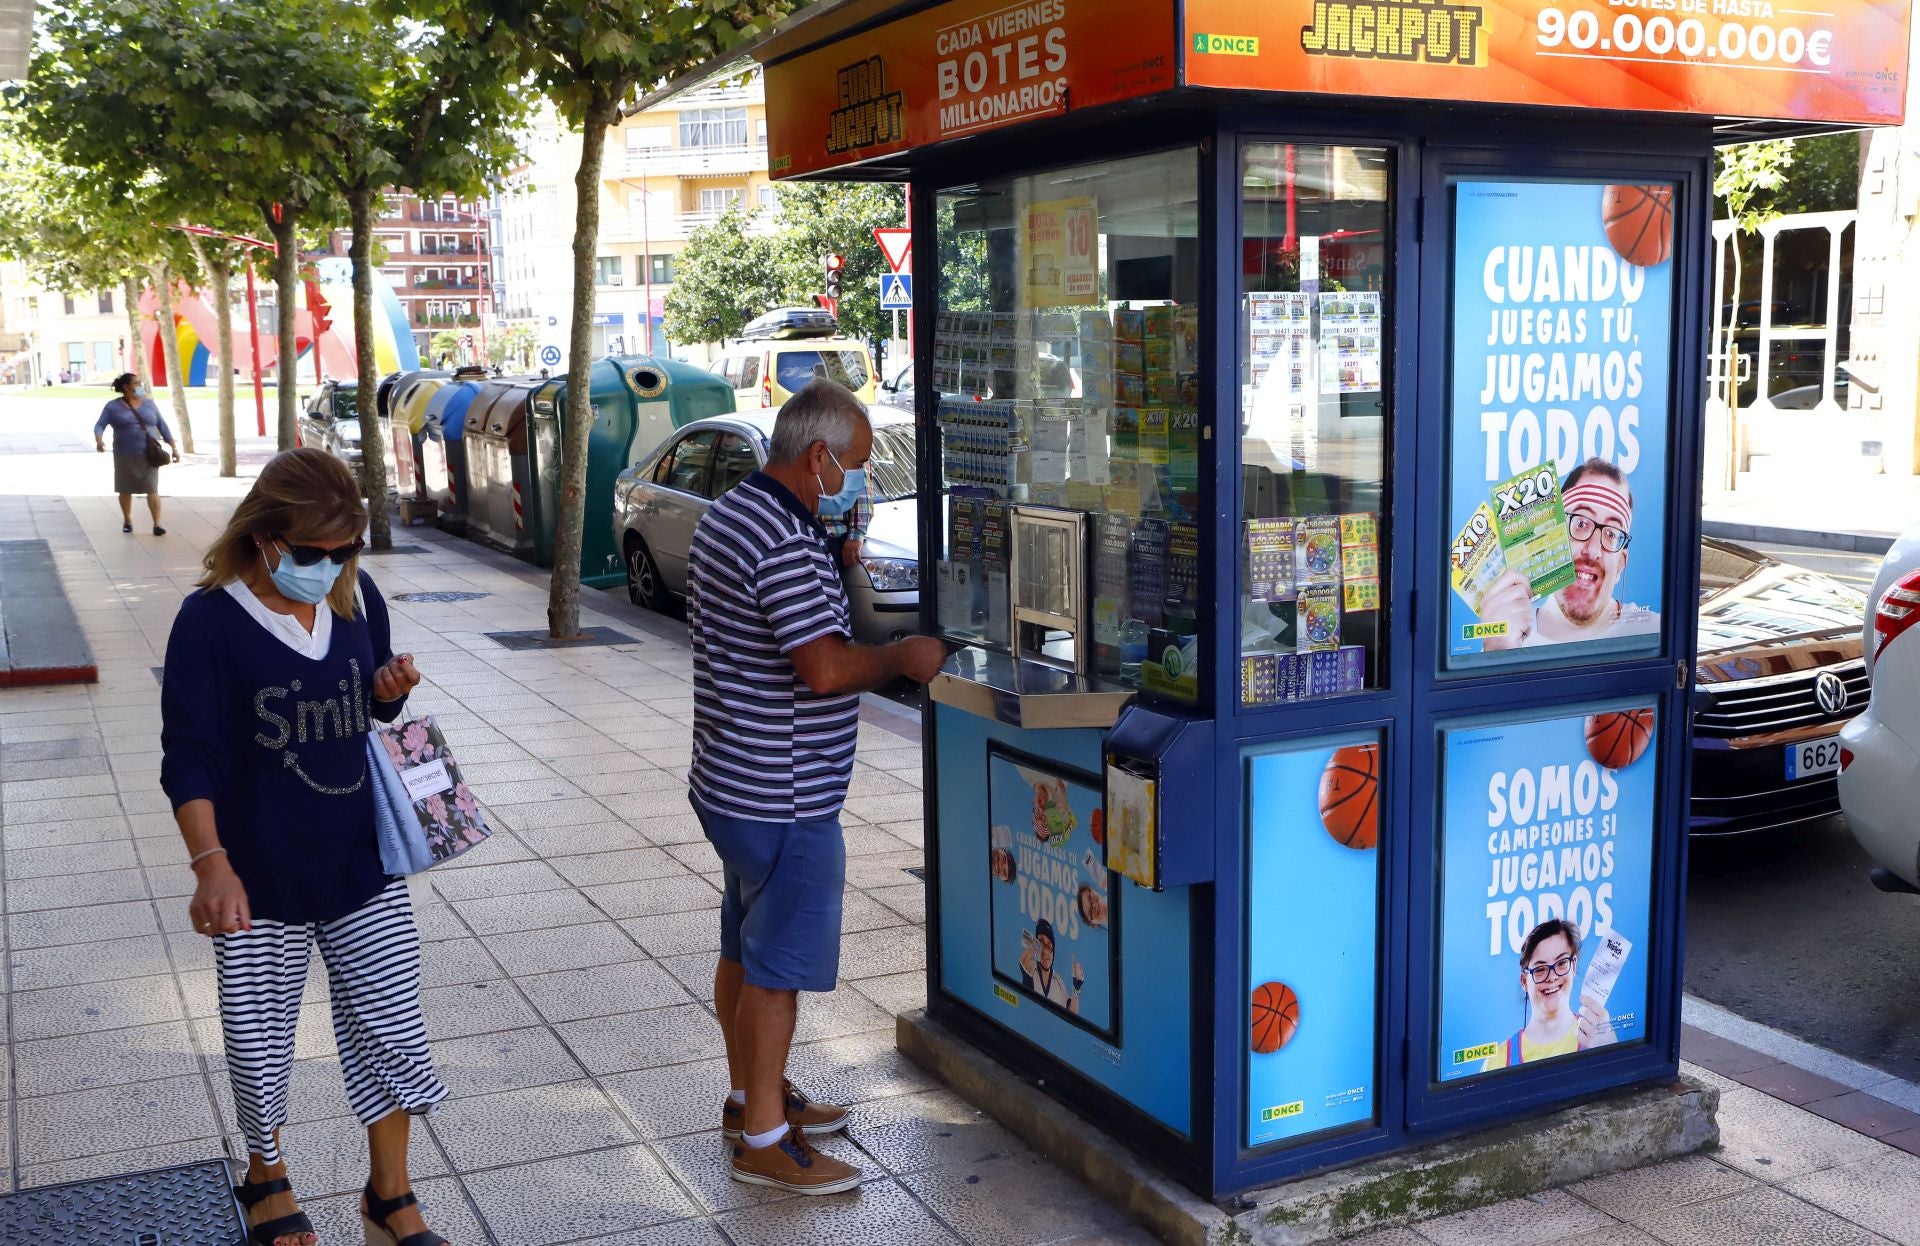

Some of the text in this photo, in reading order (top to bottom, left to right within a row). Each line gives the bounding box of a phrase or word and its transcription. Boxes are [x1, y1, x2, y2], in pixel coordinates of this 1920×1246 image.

[936, 0, 1065, 56] CADA VIERNES
[1303, 2, 1477, 59] JACKPOT
[1687, 0, 1707, 14] DE
[1713, 0, 1775, 18] HASTA
[1211, 37, 1255, 53] ONCE
[1536, 7, 1833, 66] 90.000.000€
[838, 58, 882, 107] EURO
[937, 27, 1067, 100] BOTES
[1142, 55, 1166, 70] ONCE
[1875, 71, 1899, 81] ONCE
[827, 94, 900, 152] JACKPOT
[940, 77, 1068, 130] MILLONARIOS
[1483, 245, 1646, 304] CUANDO
[1487, 307, 1588, 345] JUEGAS
[1481, 350, 1643, 406] JUGAMOS
[1481, 405, 1641, 481] TODOS
[1496, 470, 1556, 518] X20
[1476, 624, 1505, 635] ONCE
[1803, 741, 1839, 770] 662
[1488, 759, 1619, 828] SOMOS
[1488, 813, 1617, 855] CAMPEONES SI
[1018, 845, 1079, 897] JUGAMOS
[1487, 841, 1614, 898] JUGAMOS
[1017, 874, 1079, 940] TODOS
[1486, 883, 1613, 956] TODOS
[1617, 1012, 1635, 1022] ONCE
[1466, 1045, 1495, 1059] ONCE
[1273, 1103, 1300, 1117] ONCE
[1347, 1086, 1364, 1096] ONCE
